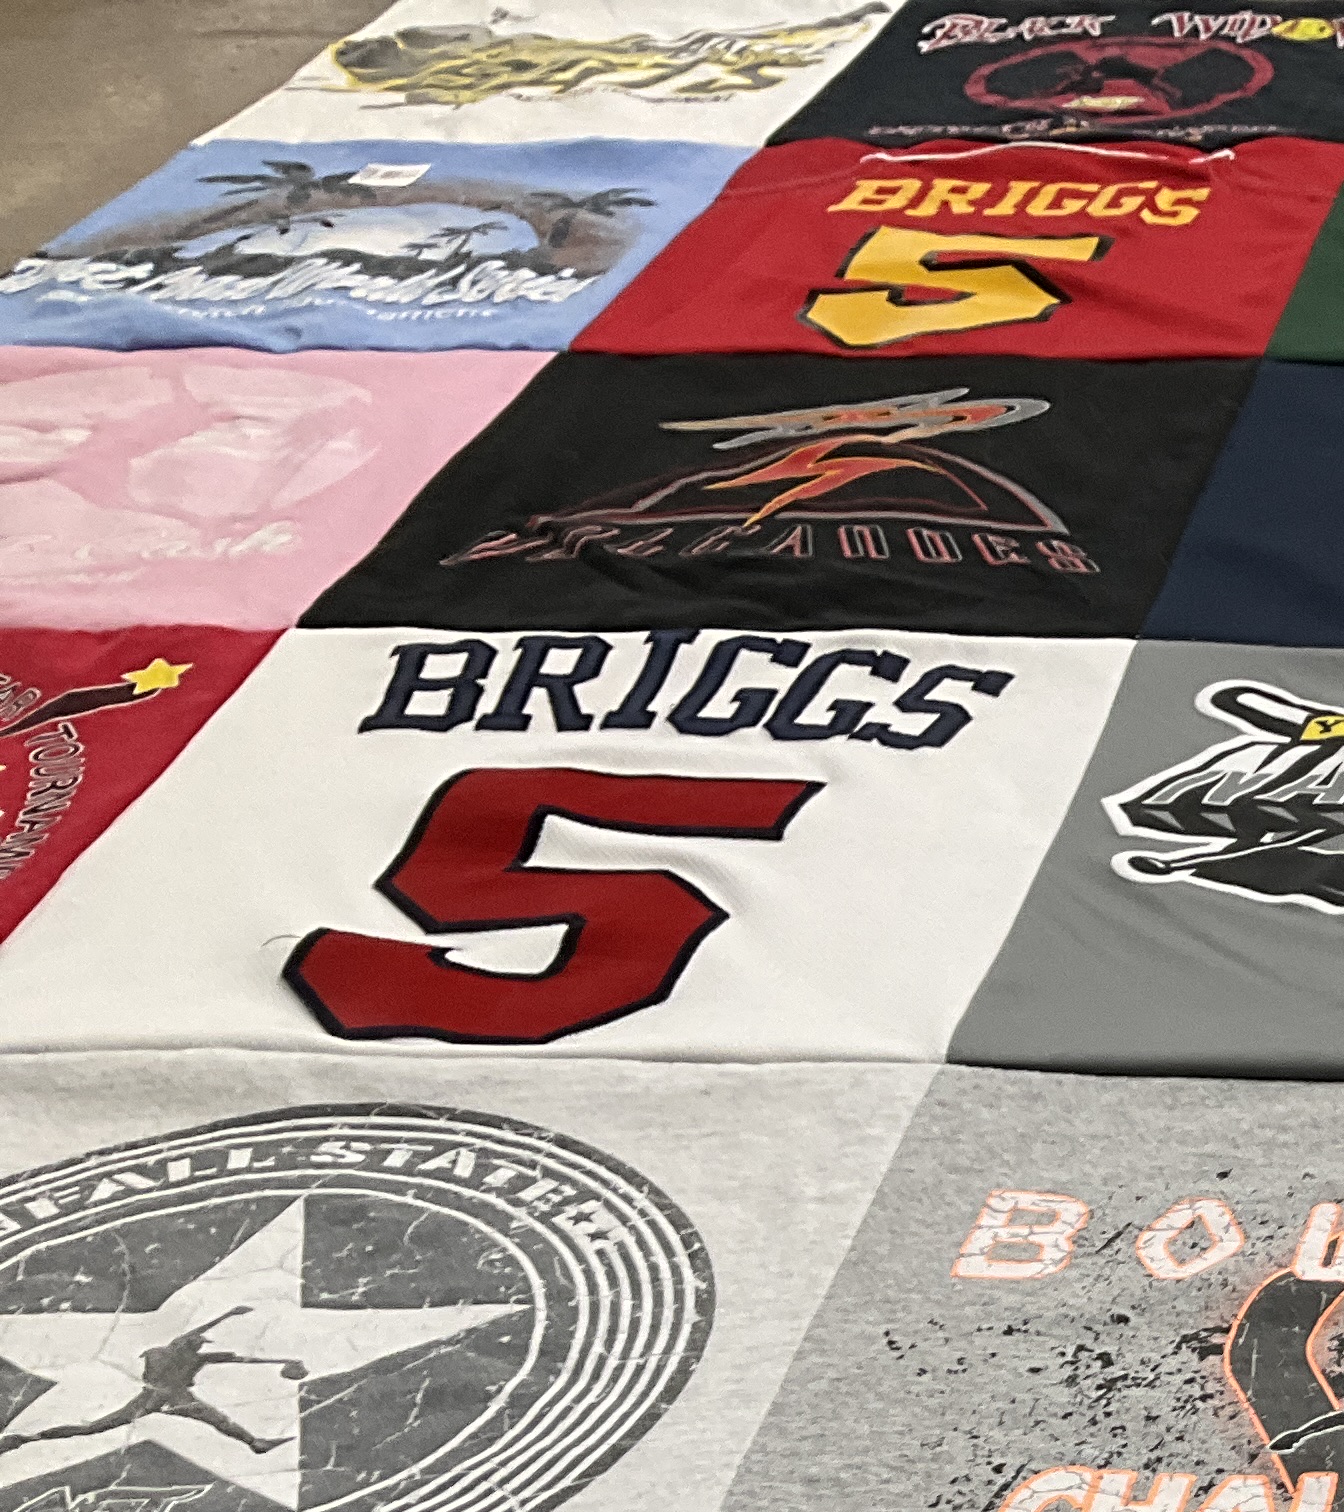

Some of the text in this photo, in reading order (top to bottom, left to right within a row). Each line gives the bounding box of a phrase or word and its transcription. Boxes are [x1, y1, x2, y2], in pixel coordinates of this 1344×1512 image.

[828, 178, 1211, 226] BRIGGS
[799, 224, 1114, 349] 5
[357, 627, 1015, 750] BRIGGS
[281, 766, 827, 1045] 5
